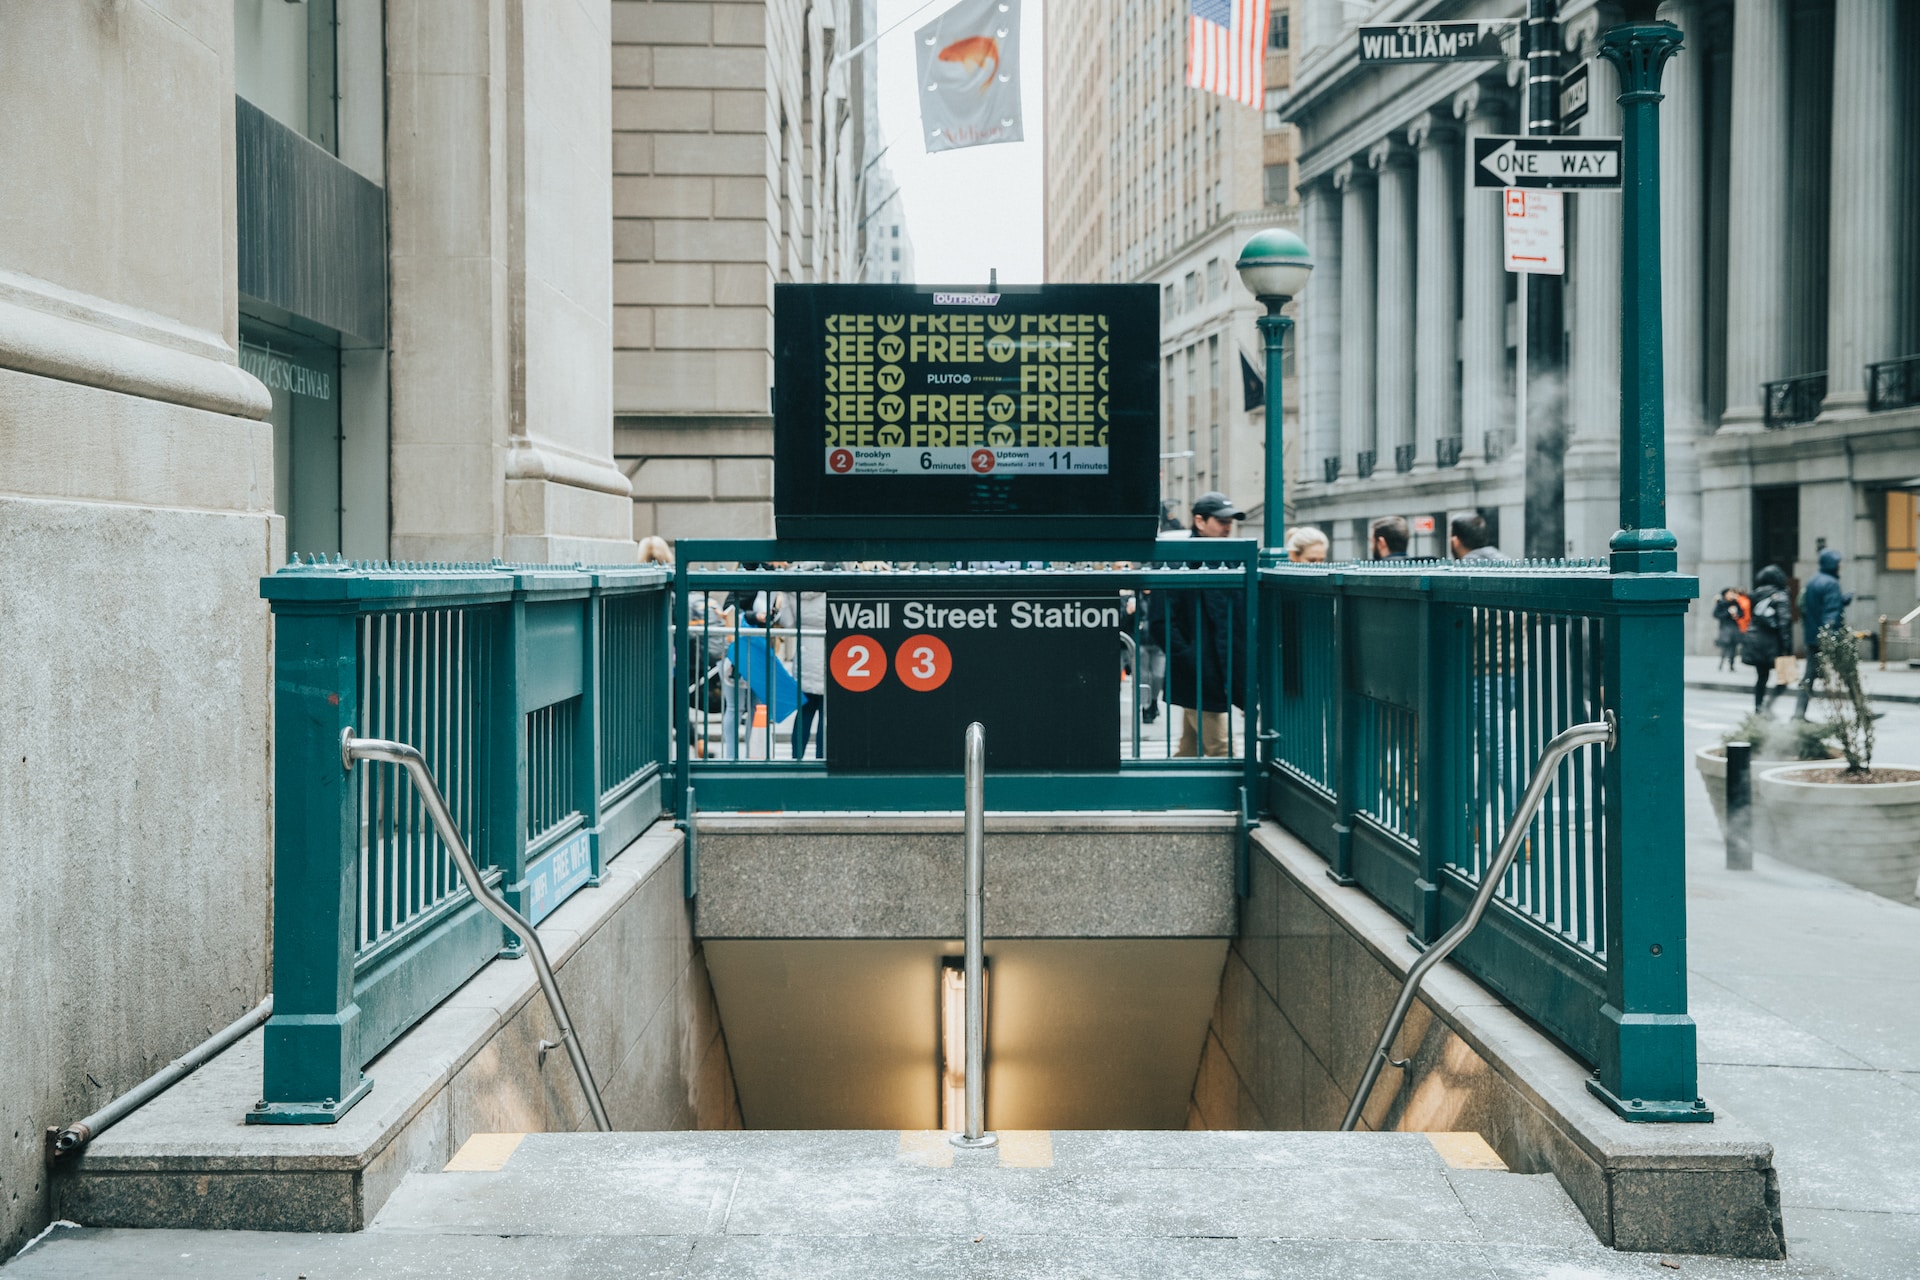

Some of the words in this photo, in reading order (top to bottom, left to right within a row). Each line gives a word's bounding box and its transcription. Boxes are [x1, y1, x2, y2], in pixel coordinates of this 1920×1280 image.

[1362, 33, 1457, 59] WILLIAM
[1458, 32, 1476, 47] ST
[1497, 153, 1538, 173] ONE
[1561, 155, 1606, 173] WAY
[936, 294, 994, 304] OUTFRONT
[910, 314, 984, 333] FREE
[1020, 314, 1095, 333] FREE
[910, 334, 984, 363] FREE
[1020, 334, 1095, 363] FREE
[282, 361, 330, 400] SCHWAB
[927, 374, 961, 384] PLUTO
[1020, 364, 1095, 393] FREE
[910, 394, 984, 422] FREE
[1020, 394, 1095, 422] FREE
[910, 424, 984, 447] FREE
[1020, 424, 1095, 447] FREE
[836, 454, 847, 468] 2
[855, 451, 891, 459] Brooklyn
[920, 452, 932, 470] 6
[932, 462, 967, 470] minutes
[978, 454, 988, 468] 2
[996, 451, 1029, 459] Uptown
[1049, 451, 1071, 470] 11
[1073, 462, 1108, 470] minutes
[830, 602, 890, 629] Wall
[903, 601, 998, 629] Street
[1010, 601, 1119, 629] Station
[847, 645, 870, 677] 2
[911, 647, 936, 679] 3
[553, 848, 570, 886] FREE
